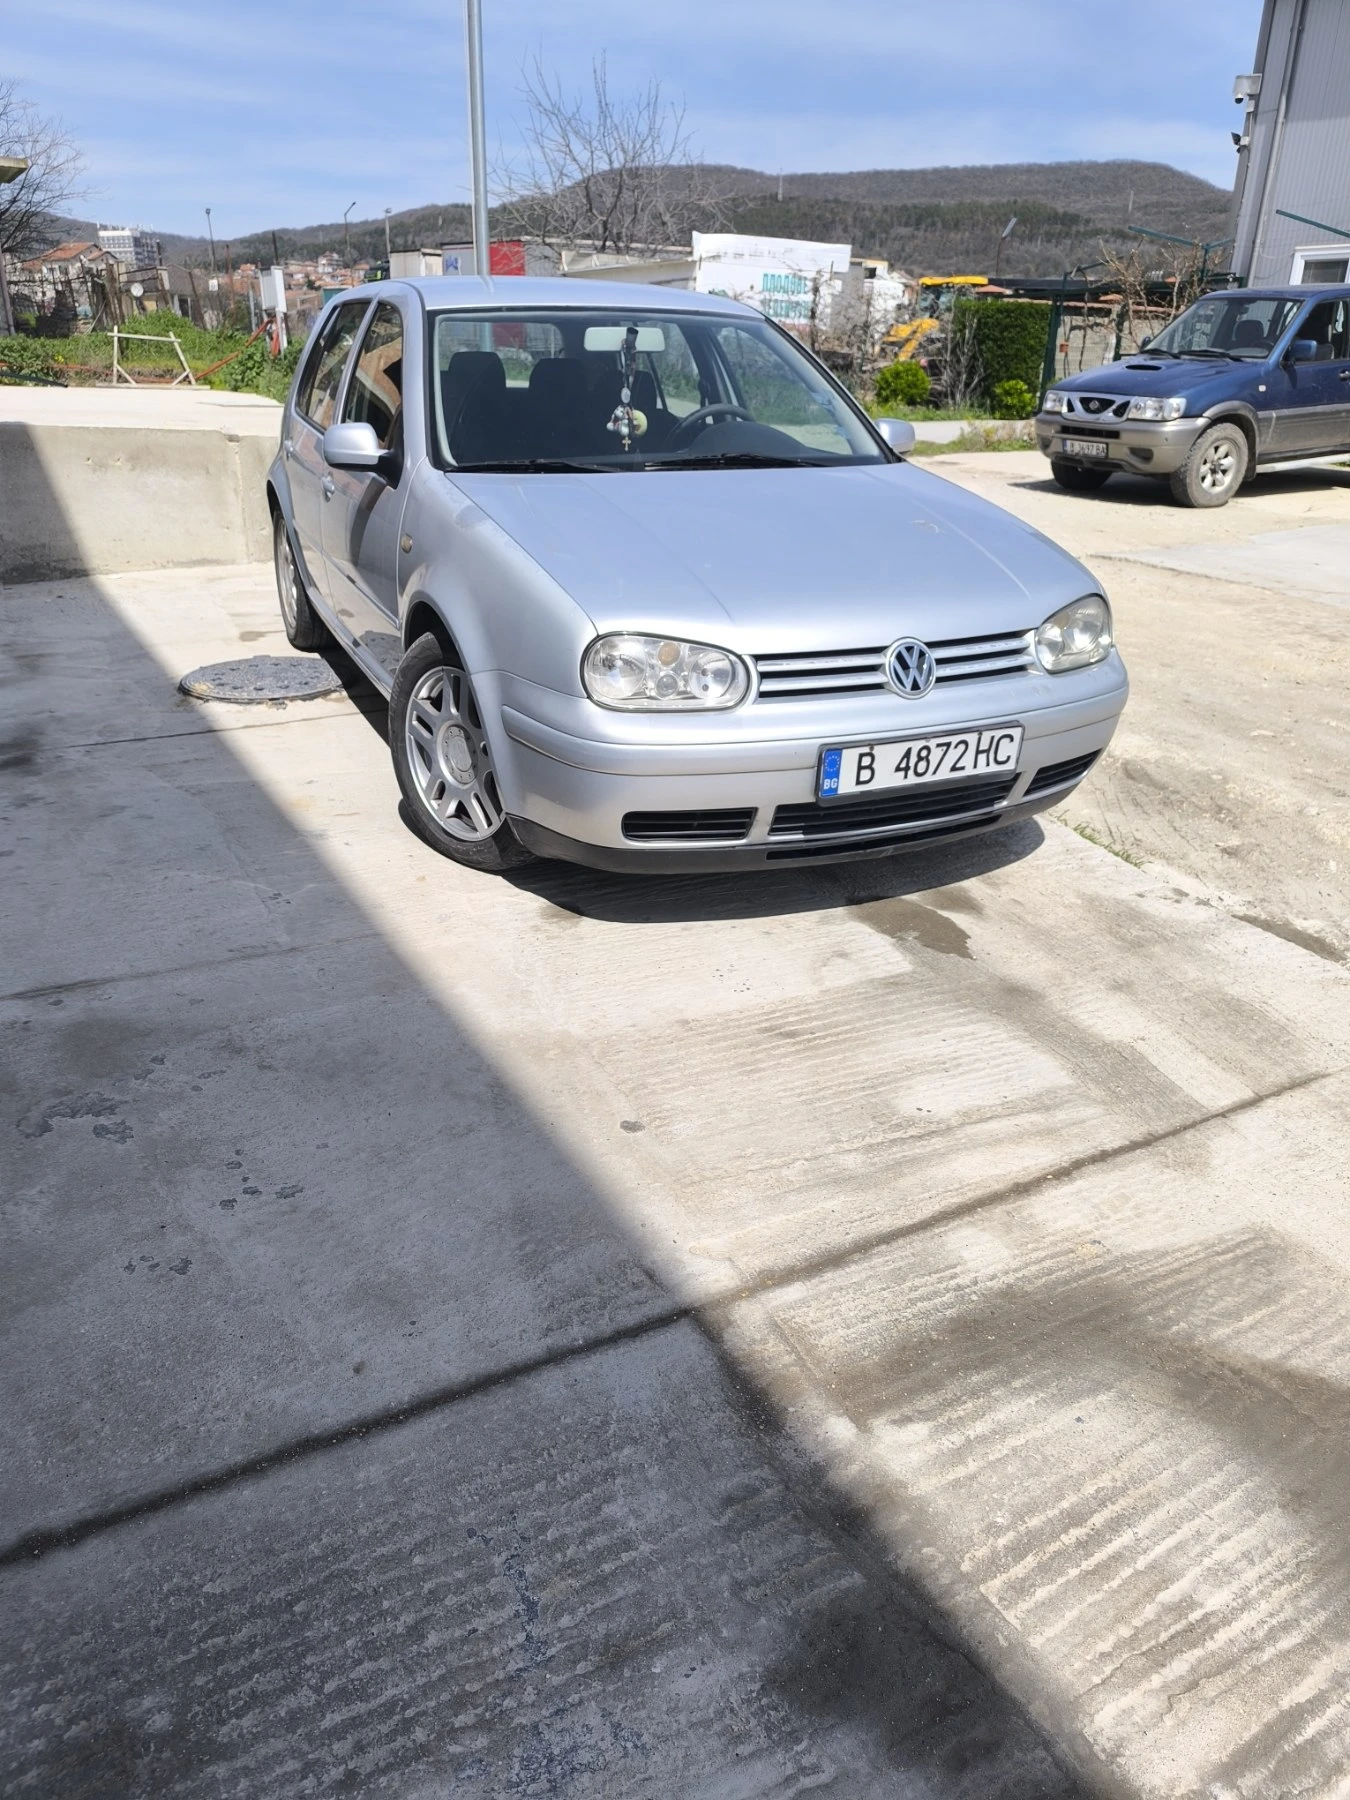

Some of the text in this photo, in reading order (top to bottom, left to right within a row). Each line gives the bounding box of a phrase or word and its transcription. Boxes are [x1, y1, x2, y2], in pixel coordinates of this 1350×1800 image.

[890, 642, 934, 695] VW
[823, 777, 838, 790] BG
[855, 733, 1015, 786] B 4872 HC
